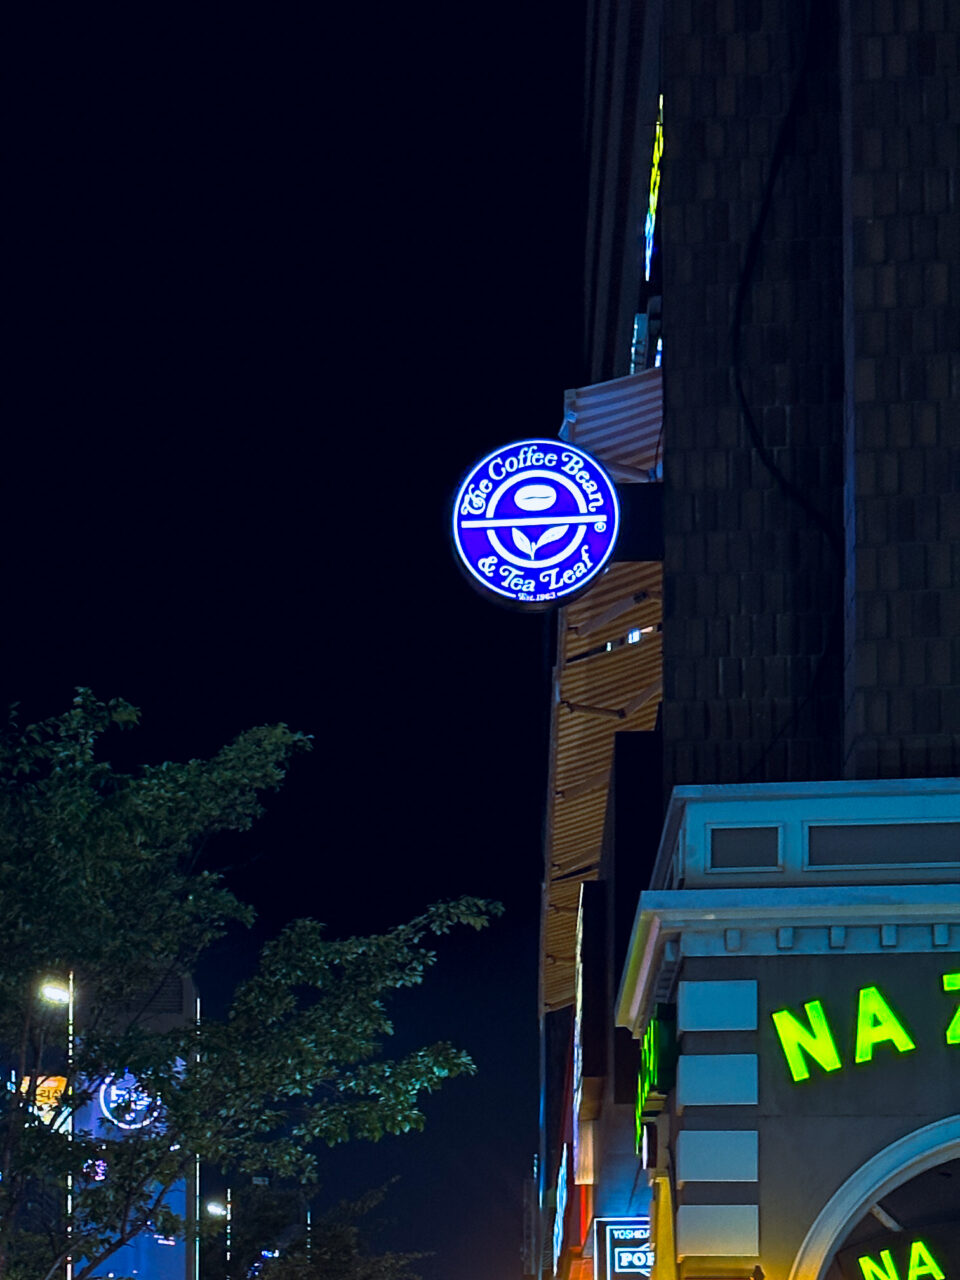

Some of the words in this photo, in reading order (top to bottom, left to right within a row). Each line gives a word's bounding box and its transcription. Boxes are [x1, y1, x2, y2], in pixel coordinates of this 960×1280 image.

[461, 478, 493, 515] The
[488, 445, 558, 481] Coffee
[561, 452, 604, 512] Bean
[477, 556, 498, 577] &
[499, 565, 536, 592] Tea
[540, 545, 593, 590] Leaf
[772, 985, 916, 1083] NA
